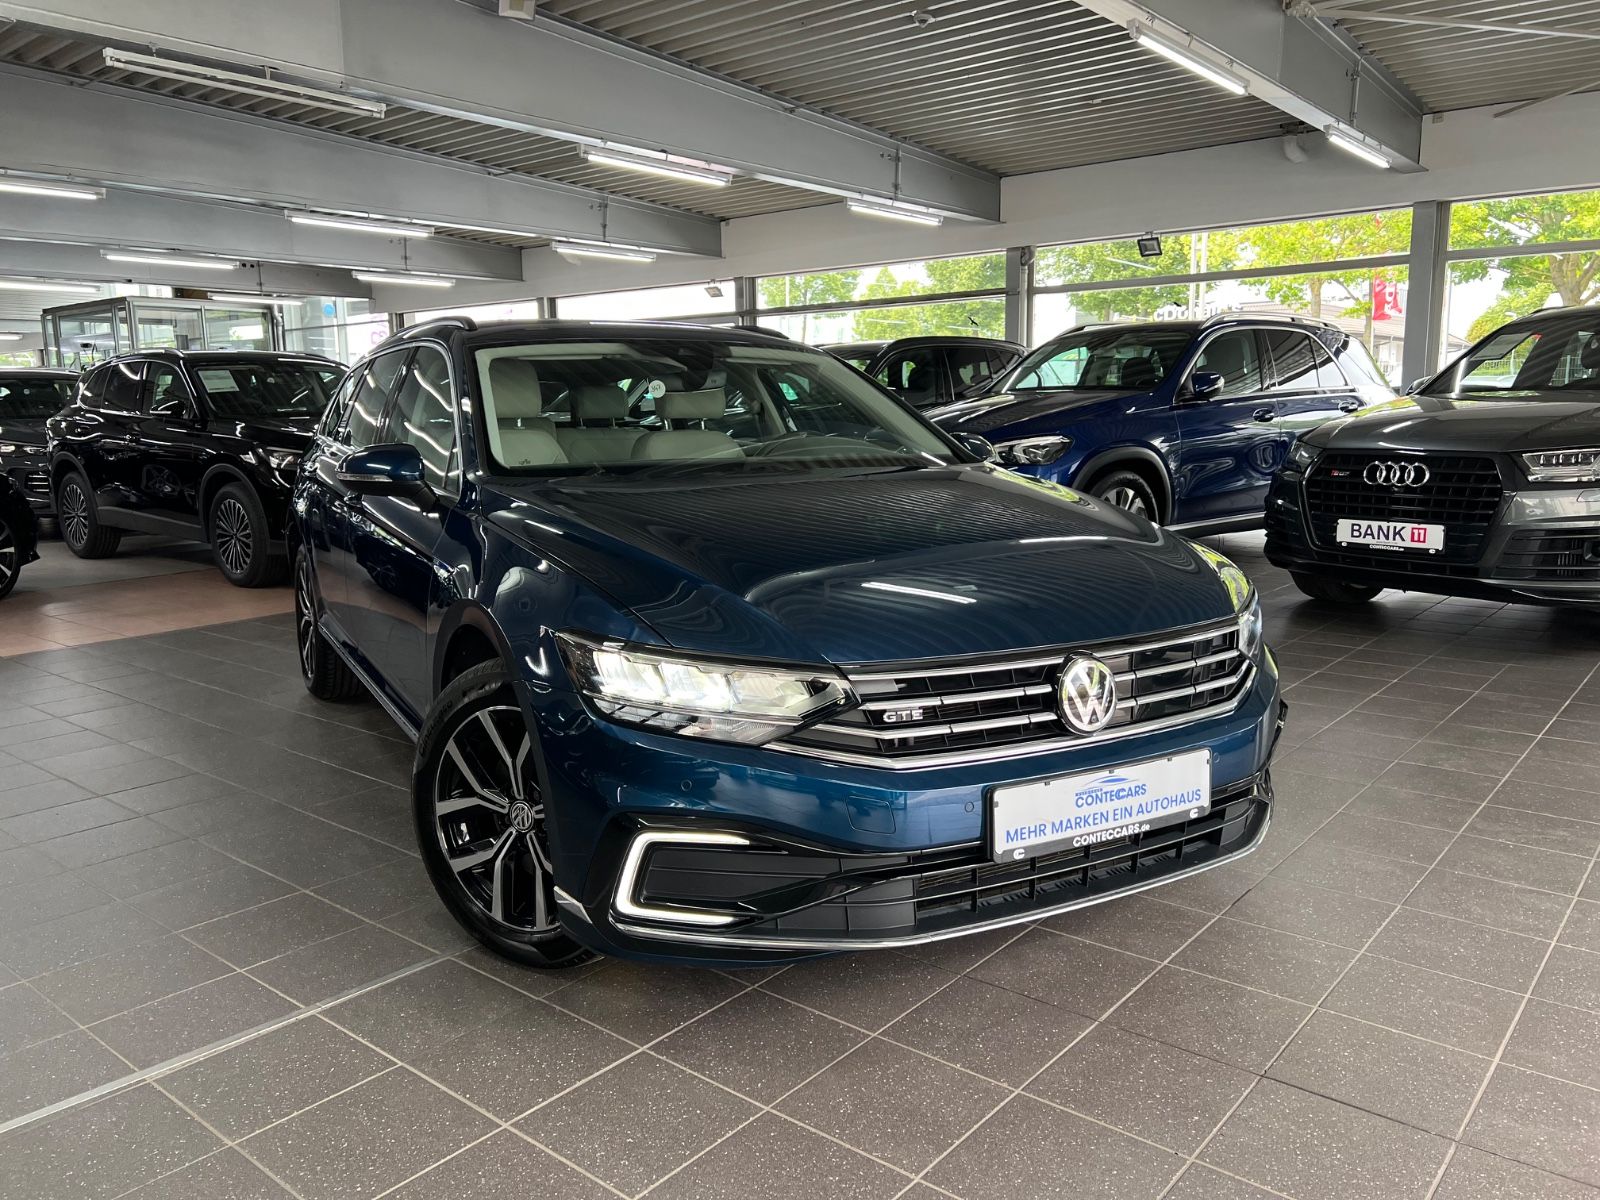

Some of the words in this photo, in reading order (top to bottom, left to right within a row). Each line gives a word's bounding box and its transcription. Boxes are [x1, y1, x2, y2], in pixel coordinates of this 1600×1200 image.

[1350, 523, 1407, 542] BANK
[1412, 528, 1426, 543] 11
[883, 708, 924, 723] GTE
[1005, 823, 1047, 844] MEHR
[1051, 810, 1110, 835] MARKEN
[1113, 806, 1133, 822] EIN
[1136, 789, 1201, 816] AUTOHAUS
[1073, 823, 1151, 848] CONTECCARS.de
